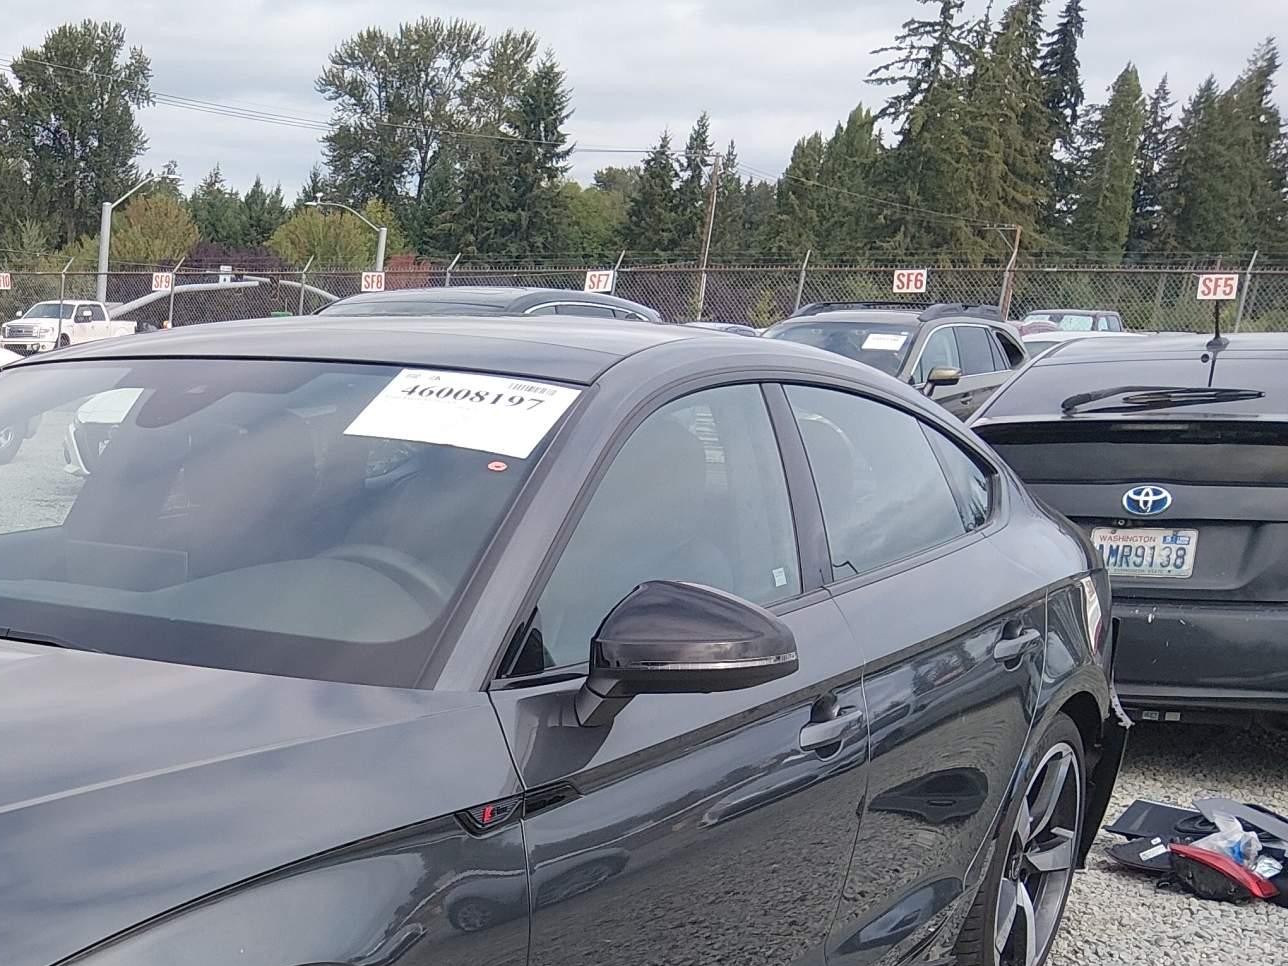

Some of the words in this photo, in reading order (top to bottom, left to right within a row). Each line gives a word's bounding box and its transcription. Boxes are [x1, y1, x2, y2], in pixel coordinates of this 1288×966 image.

[154, 274, 171, 289] SF9
[364, 274, 383, 290] SF8
[588, 273, 610, 290] SF7
[896, 272, 924, 290] SF6
[1200, 276, 1235, 297] SF5
[400, 383, 544, 411] 46008197
[1099, 534, 1157, 544] WASHINGTON
